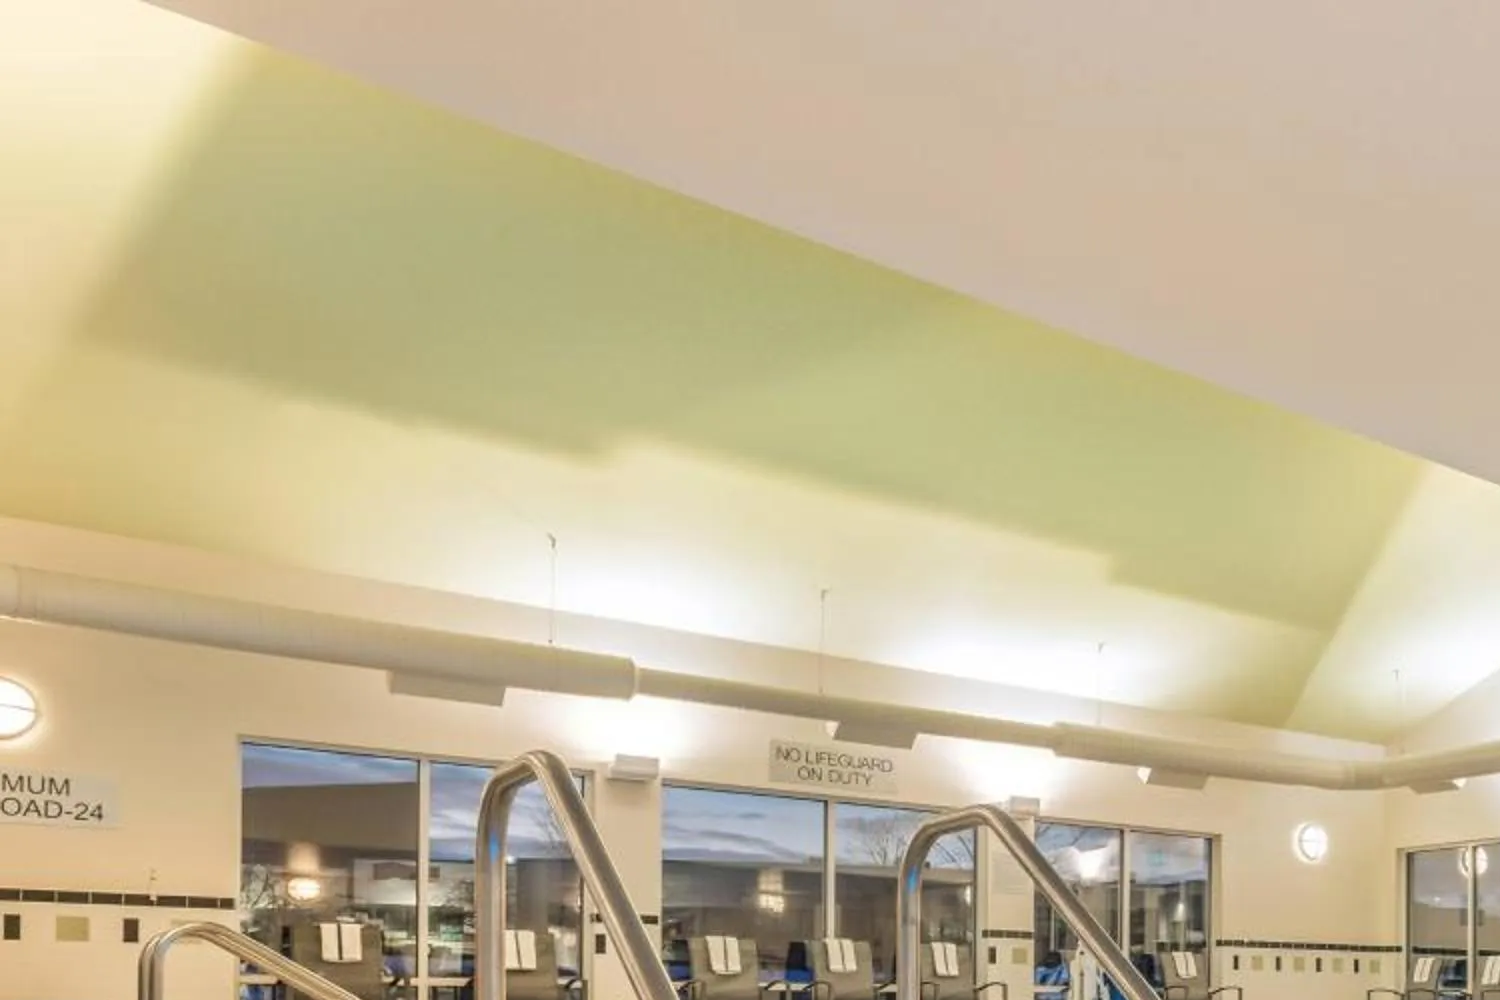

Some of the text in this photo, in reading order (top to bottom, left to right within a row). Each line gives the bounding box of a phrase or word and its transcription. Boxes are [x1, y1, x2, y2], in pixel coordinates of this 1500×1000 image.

[775, 745, 893, 773] NO LIFEGUARD
[2, 773, 71, 796] MUM
[797, 765, 873, 786] ON DUTY
[0, 797, 104, 822] OAD-24
